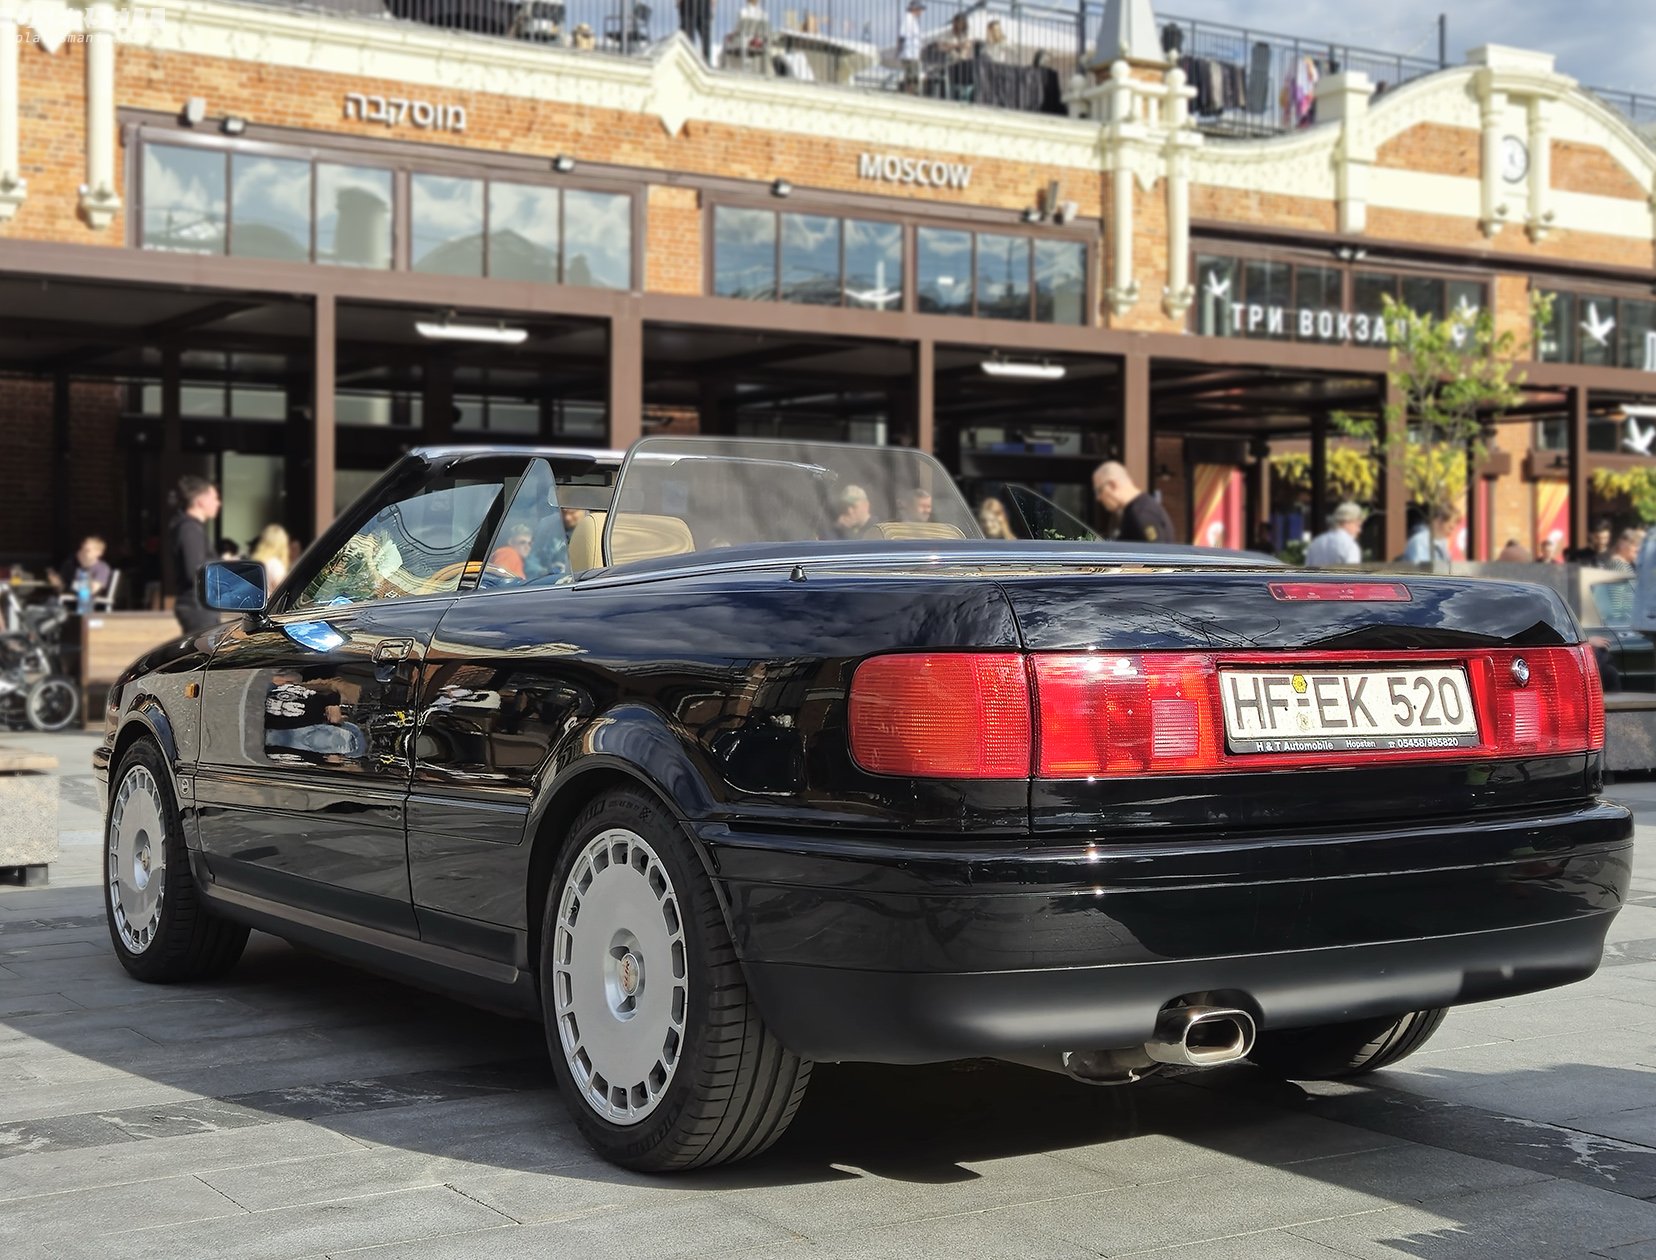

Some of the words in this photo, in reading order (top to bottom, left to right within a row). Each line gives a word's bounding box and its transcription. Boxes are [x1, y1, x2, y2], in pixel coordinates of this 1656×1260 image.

[344, 91, 467, 132] מוסקבה
[859, 152, 972, 190] MOSCOW
[1231, 302, 1284, 334] ТРИ
[1387, 676, 1464, 728] 520
[1256, 741, 1265, 752] H
[1265, 741, 1274, 752] &
[1274, 741, 1281, 751] T
[1284, 740, 1334, 752] Automobile
[1345, 739, 1376, 750] Hopsten
